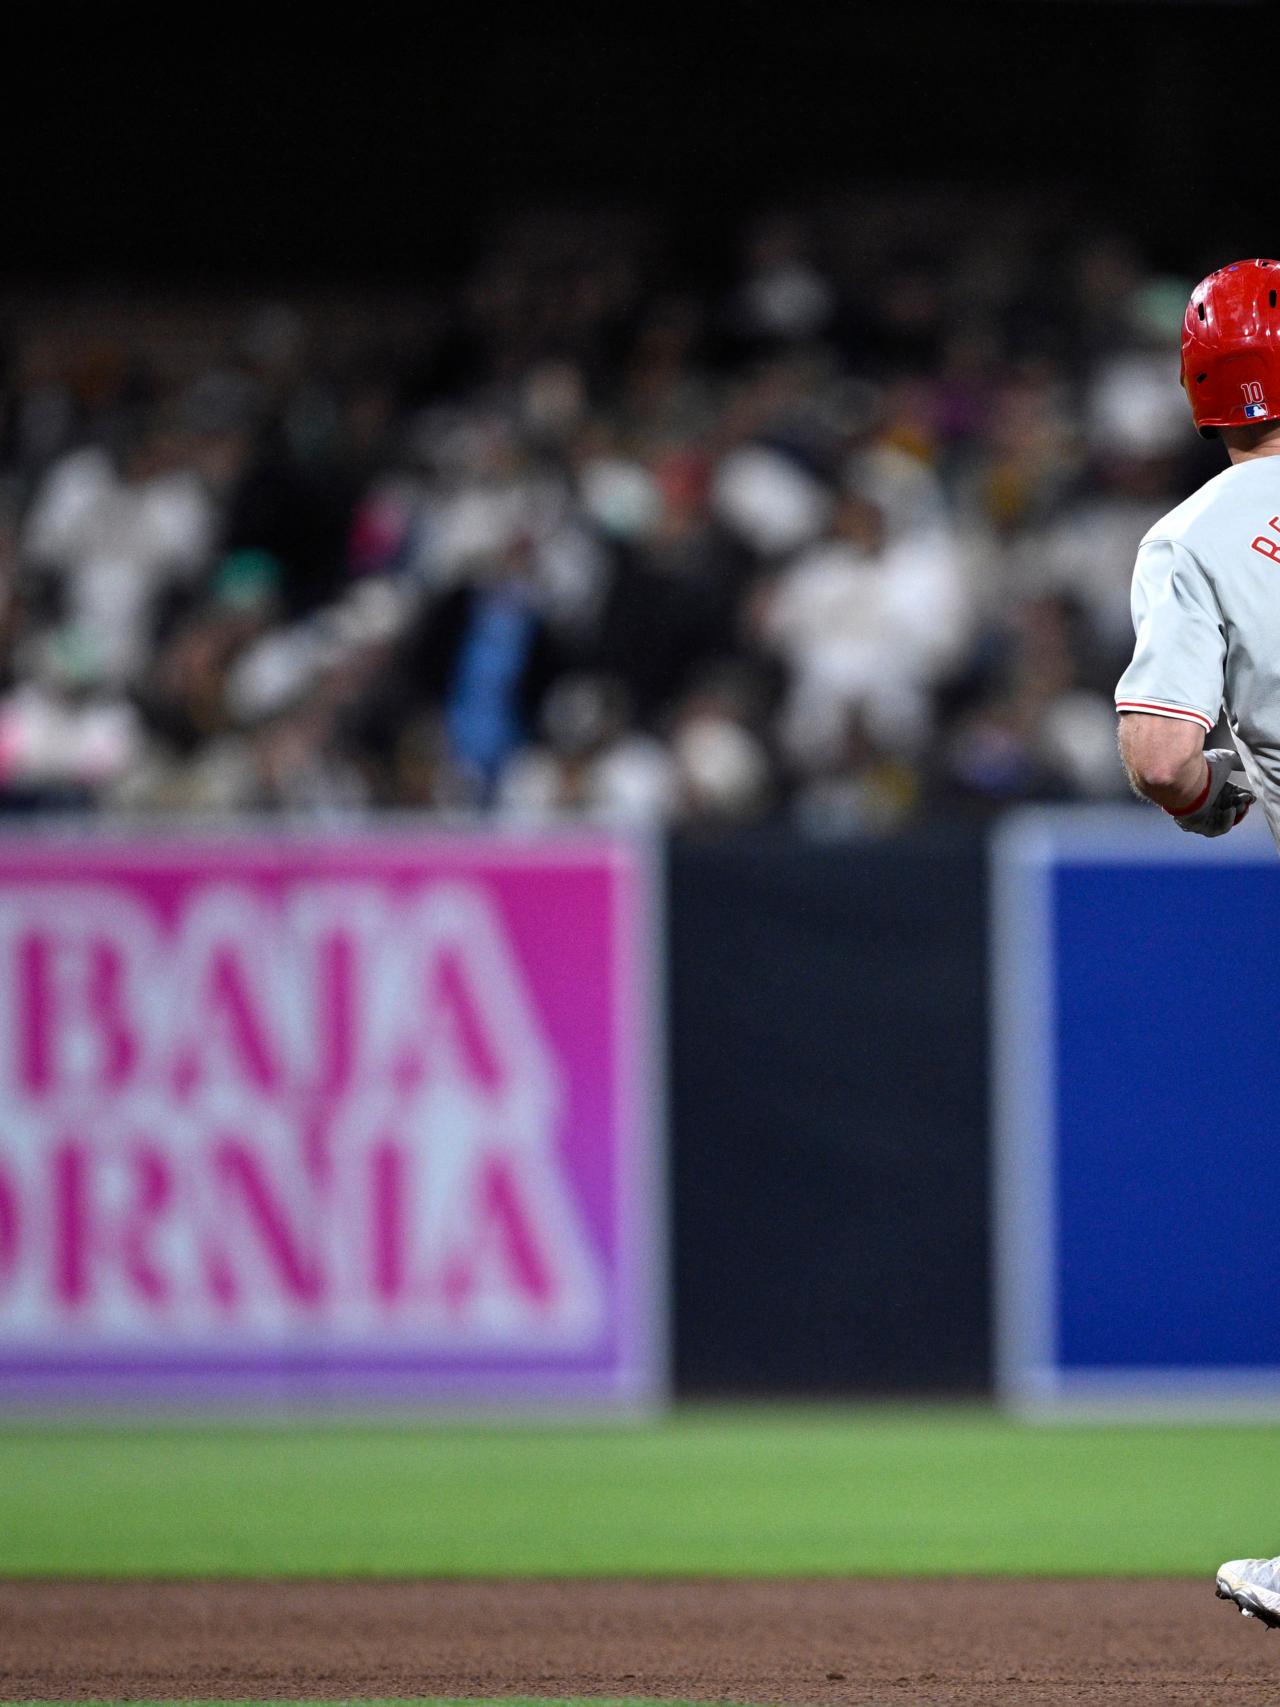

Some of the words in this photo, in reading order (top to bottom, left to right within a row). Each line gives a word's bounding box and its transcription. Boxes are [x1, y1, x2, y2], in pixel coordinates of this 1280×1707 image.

[1241, 381, 1265, 404] 10
[10, 912, 512, 1180] BAJA
[0, 1132, 560, 1312] RNIA
